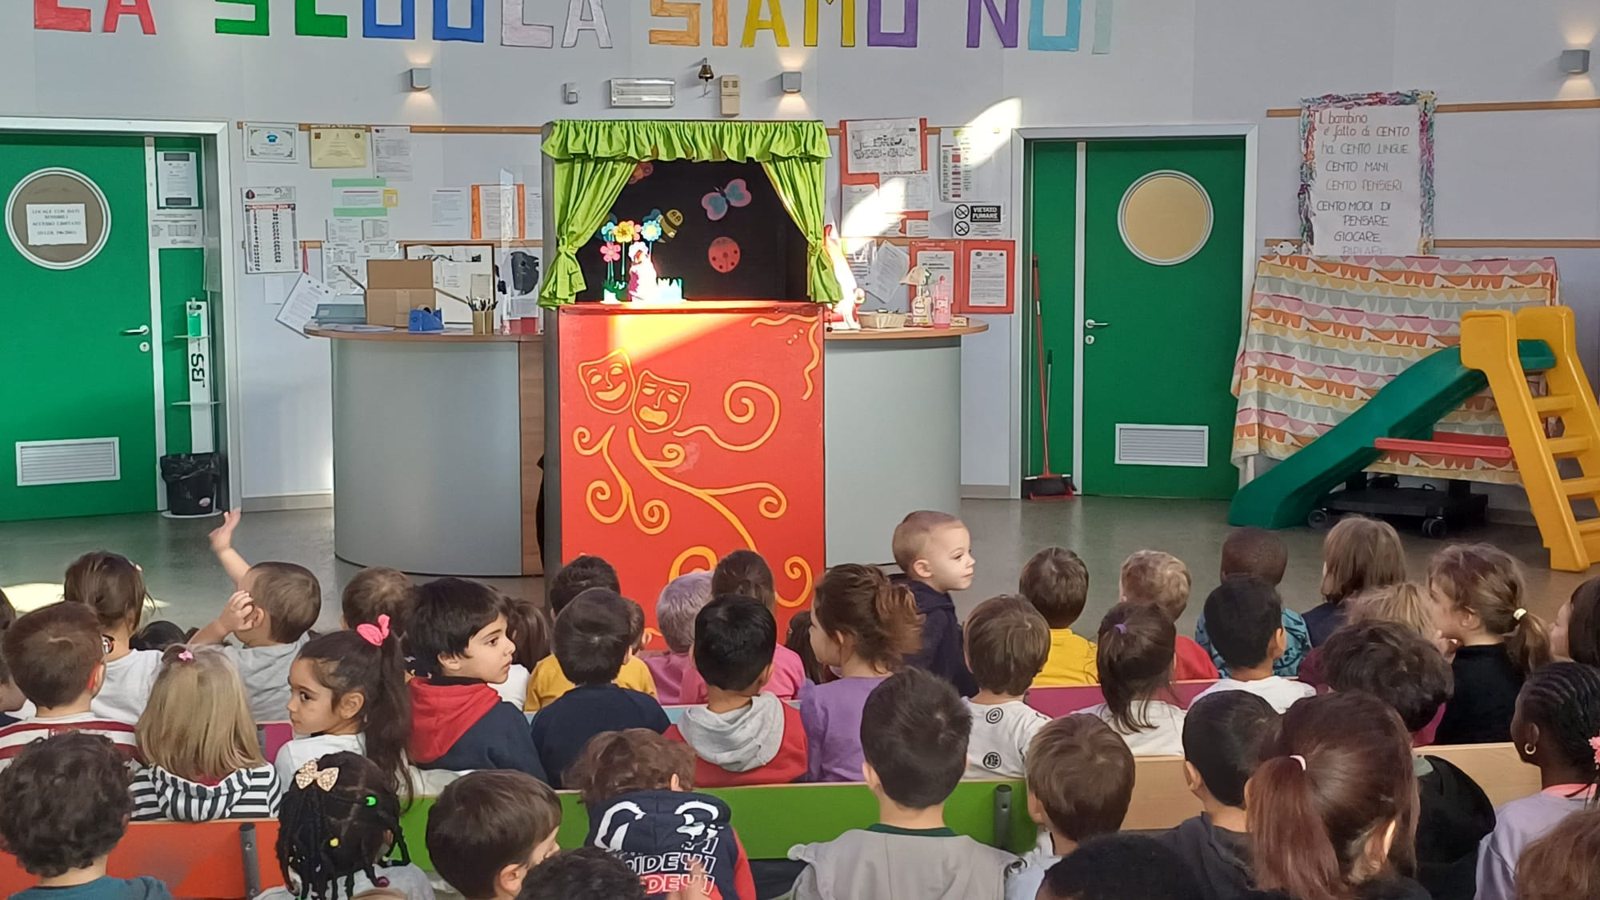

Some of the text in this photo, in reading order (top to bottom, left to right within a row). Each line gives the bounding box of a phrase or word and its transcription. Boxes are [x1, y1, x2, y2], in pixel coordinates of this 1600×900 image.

[1329, 110, 1368, 124] bambino
[1333, 125, 1357, 142] fatto
[1361, 125, 1370, 136] di
[1376, 126, 1410, 137] CENTO
[1321, 141, 1409, 155] ha CENTO LINGUE
[1325, 160, 1389, 173] CENTO MANI
[1326, 178, 1402, 191] CENTO PENSIERI
[1316, 200, 1391, 211] CENTO MODI DI
[1343, 214, 1389, 226] PENSARE
[1333, 230, 1381, 242] GIOCARE
